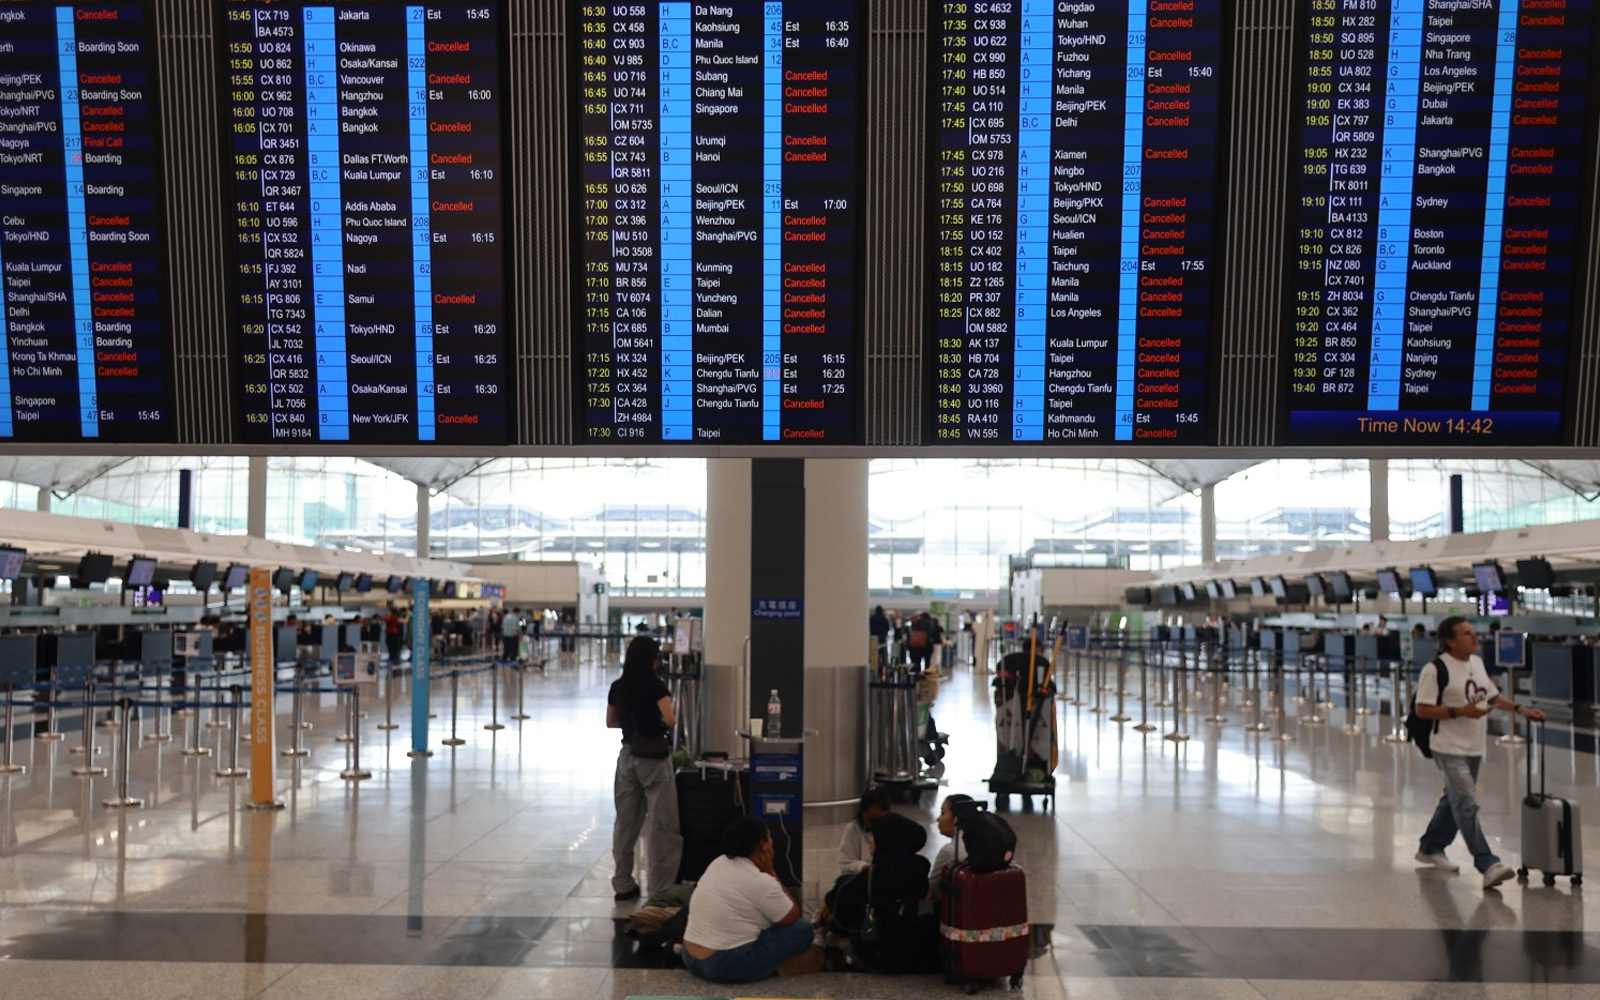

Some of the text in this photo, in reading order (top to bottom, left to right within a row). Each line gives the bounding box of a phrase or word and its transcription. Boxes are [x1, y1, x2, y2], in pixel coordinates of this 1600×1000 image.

[227, 8, 490, 21] 15:45 CX 719 B Jakarta 27 Est 15:45
[582, 5, 782, 18] 16:30 UO 558 H Da Nang 206
[942, 34, 1146, 48] 17:35 UO 622 H Tokyo/HND 219
[1310, 32, 1516, 45] 18:50 SQ 895 F Singapore 28
[583, 69, 828, 84] 16:45 UO 716 H Subang Cancelled
[1308, 64, 1561, 78] 18:55 UA 802 G Los Angeles Cancelled
[231, 73, 471, 86] 15:55 CX 810 B,C Vancouver Cancelled
[941, 115, 1190, 129] 17:45 CX 695 B,C Delhi Cancelled
[64, 136, 82, 148] 217
[83, 137, 105, 147] Final
[106, 137, 123, 148] Call
[234, 153, 473, 165] 16:05 CX 876 B Dallas FT.Worth Cancelled
[1, 184, 124, 197] Singapore 14 Boarding
[265, 185, 302, 197] QR 3467
[1301, 195, 1551, 209] 19:10 CX 111 A Sydney Cancelled
[2, 215, 130, 226] Cebu Cancelled
[3, 230, 150, 244] Tokyo/HND 7 Boarding Soon
[585, 230, 827, 244] 17:05 MU 510 J Shanghai/PVG Cancelled
[6, 261, 133, 274] Kuala Lumpur Cancelled
[939, 260, 1205, 274] 18:15 UO 182 H Taichung 204 Est 17:55
[8, 291, 134, 304] Shanghai/SHA Cancelled
[1297, 290, 1544, 304] 19:15 ZH 8034 G Chengdu Tianfu Cancelled
[11, 351, 137, 363] Krong Ta Khmau Cancelled
[587, 352, 846, 366] 17:15 HX 324 K Beijing/PEK 205 Est 16:15
[938, 352, 1181, 365] 18:30 HB 704 Taipei Cancelled
[938, 397, 1179, 410] 18:40 UO 116 H Taipei Cancelled
[15, 410, 161, 422] Taipei 47 Est 15:45
[246, 413, 479, 424] 16:30 CX 840 B New York/JFK Cancelled
[1357, 417, 1494, 434] Time Now 14:42
[754, 609, 801, 618] Charging point
[416, 591, 426, 680] ECONOMY CLASS
[255, 626, 268, 744] BUSINESS CLASS
